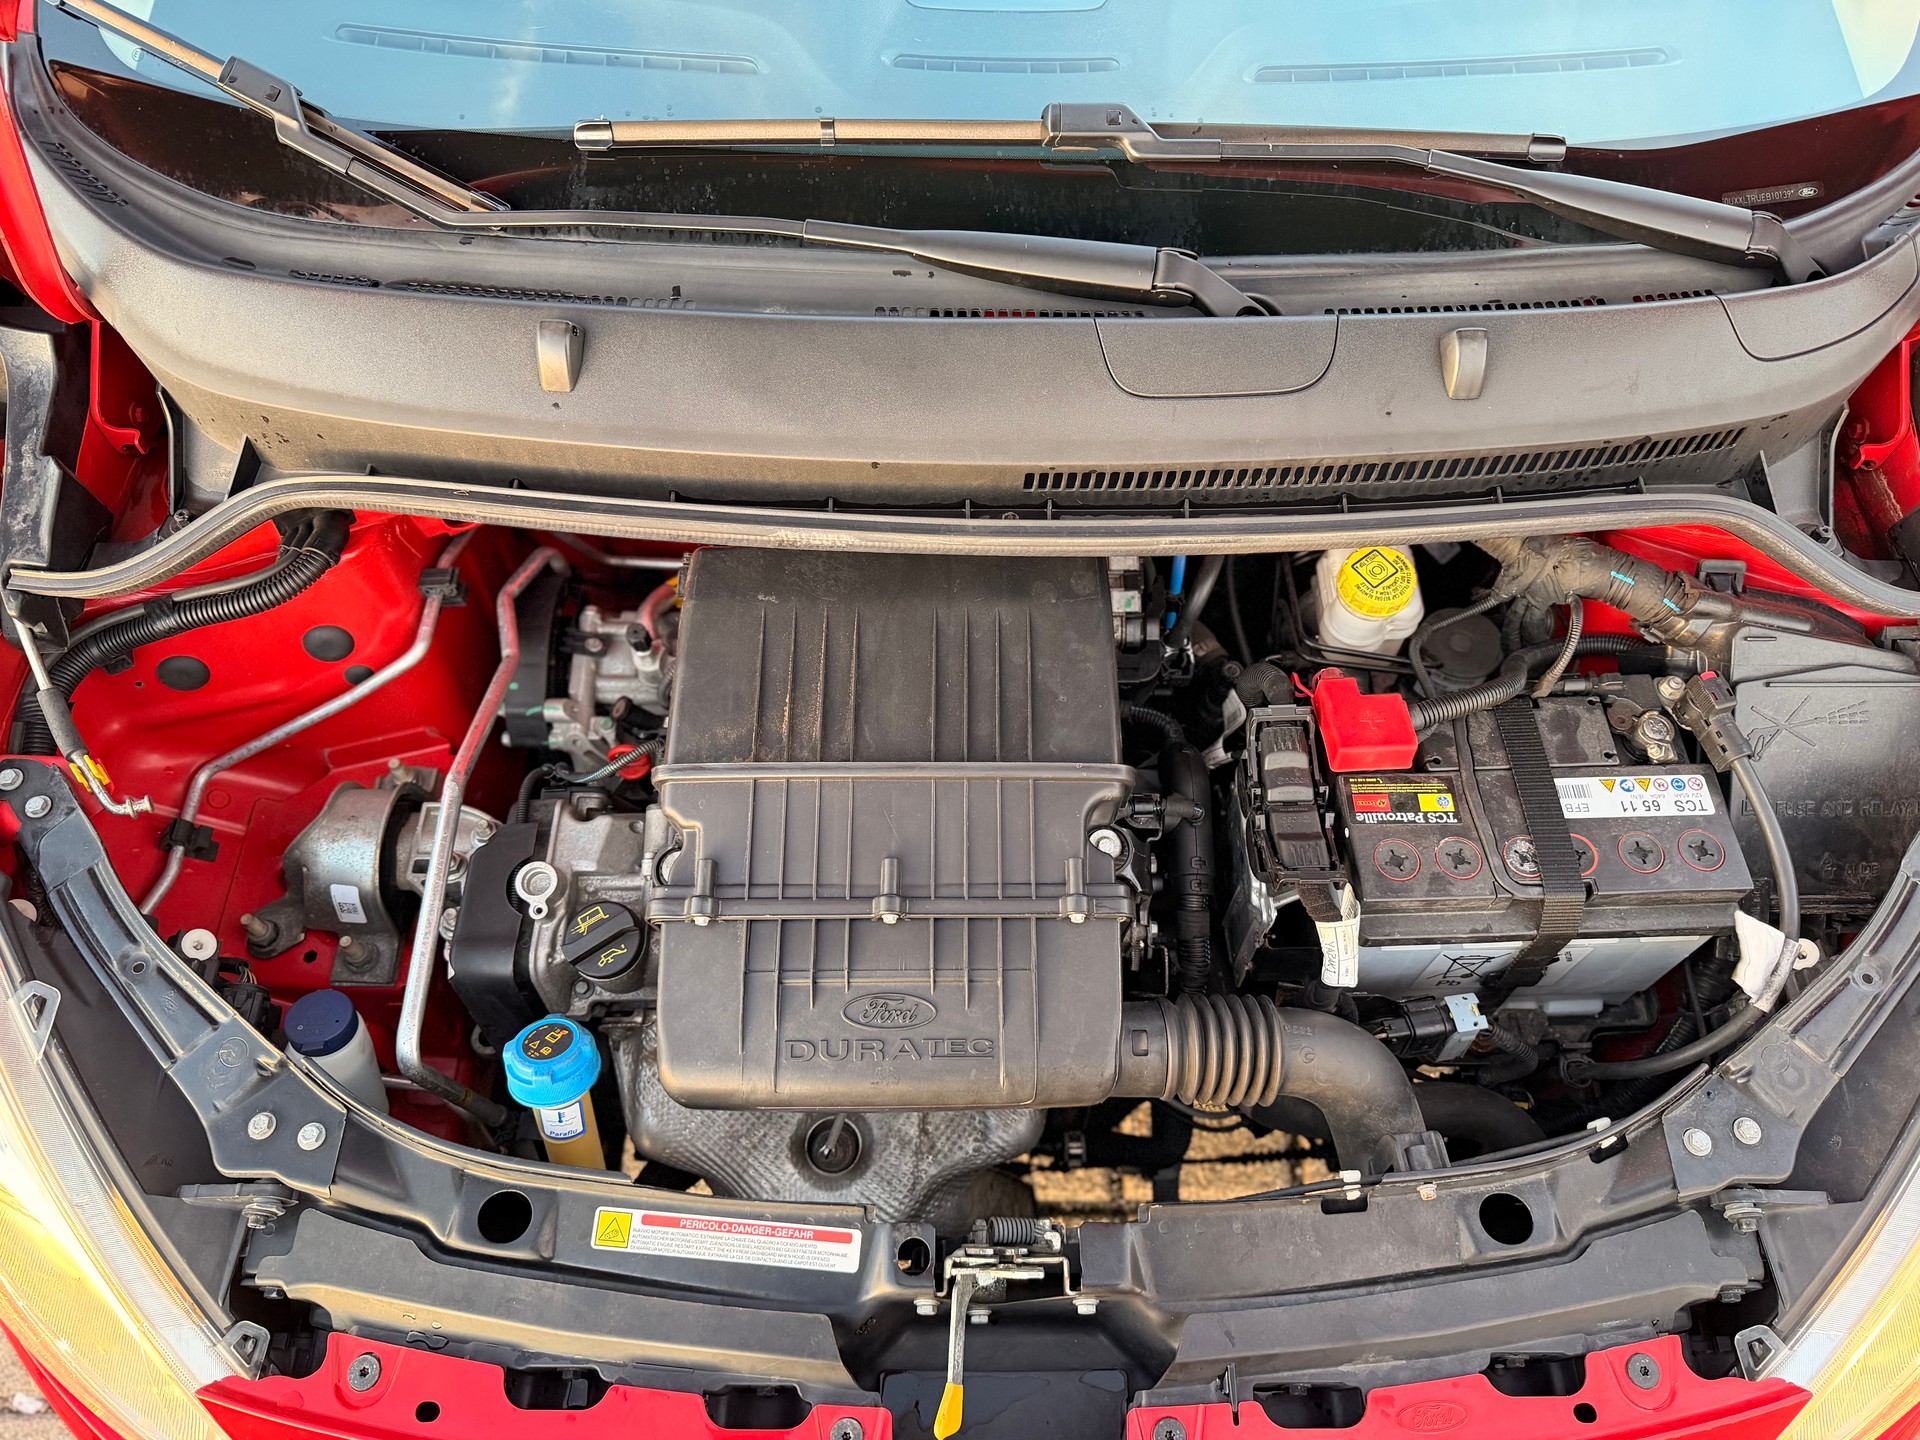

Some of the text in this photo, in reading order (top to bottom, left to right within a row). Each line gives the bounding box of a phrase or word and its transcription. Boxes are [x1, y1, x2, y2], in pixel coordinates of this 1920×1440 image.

[1565, 803, 1590, 812] EFB
[1621, 800, 1708, 812] TCS 65 11
[1776, 800, 1815, 816] FUSE
[1820, 800, 1853, 816] AND
[1859, 800, 1911, 816] RELAY
[1356, 812, 1458, 823] TCS Patrouille
[860, 997, 917, 1024] Ford
[783, 1038, 994, 1062] DURATEC
[680, 1218, 814, 1239] PERICOLO-DANGER-GEFAHR
[1414, 1405, 1454, 1429] Ford
